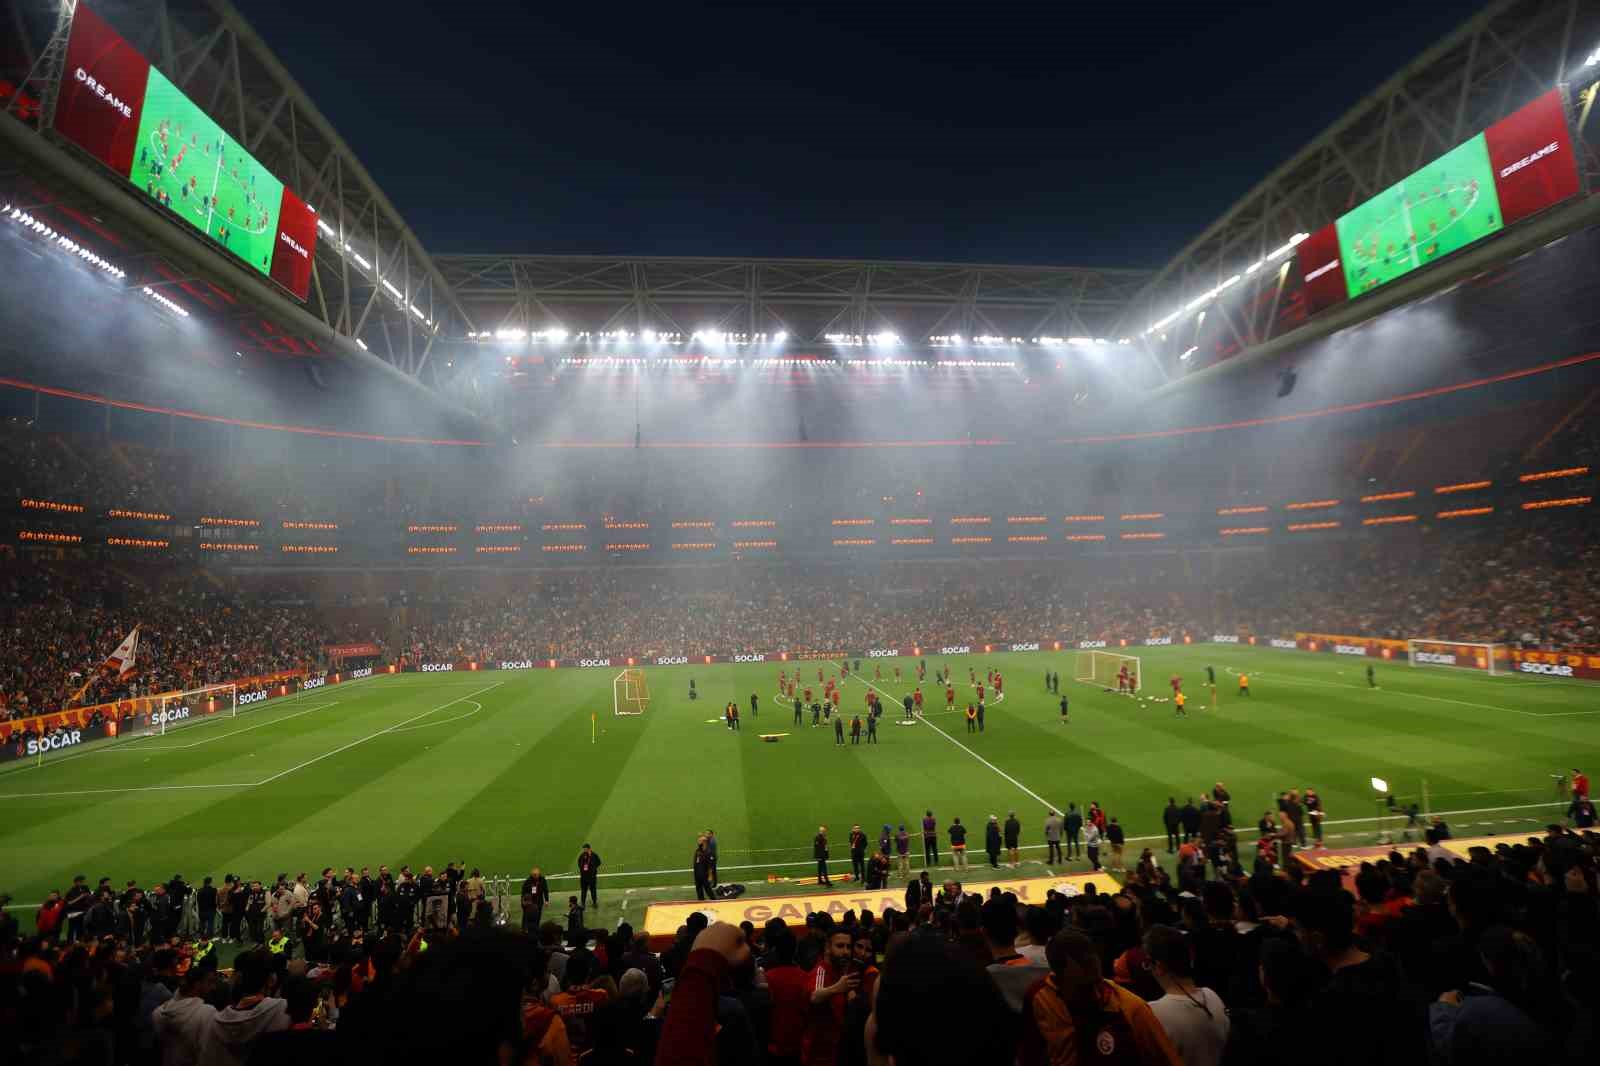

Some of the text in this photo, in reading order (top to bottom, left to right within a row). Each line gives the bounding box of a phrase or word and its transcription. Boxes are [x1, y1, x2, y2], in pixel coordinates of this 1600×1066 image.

[75, 67, 132, 118] DREAME
[1500, 141, 1559, 178] DREAME
[870, 650, 899, 658] SOCAR
[942, 646, 970, 655] SOCAR
[580, 659, 610, 667] SOCAR
[657, 656, 688, 665] SOCAR
[735, 654, 765, 663] SOCAR
[422, 664, 453, 672] SOCAR
[501, 660, 533, 670] SOCAR
[303, 677, 325, 690] SOCAR
[239, 690, 268, 705] SOCAR
[152, 707, 189, 725] SOCAR
[27, 731, 81, 755] SOCAR
